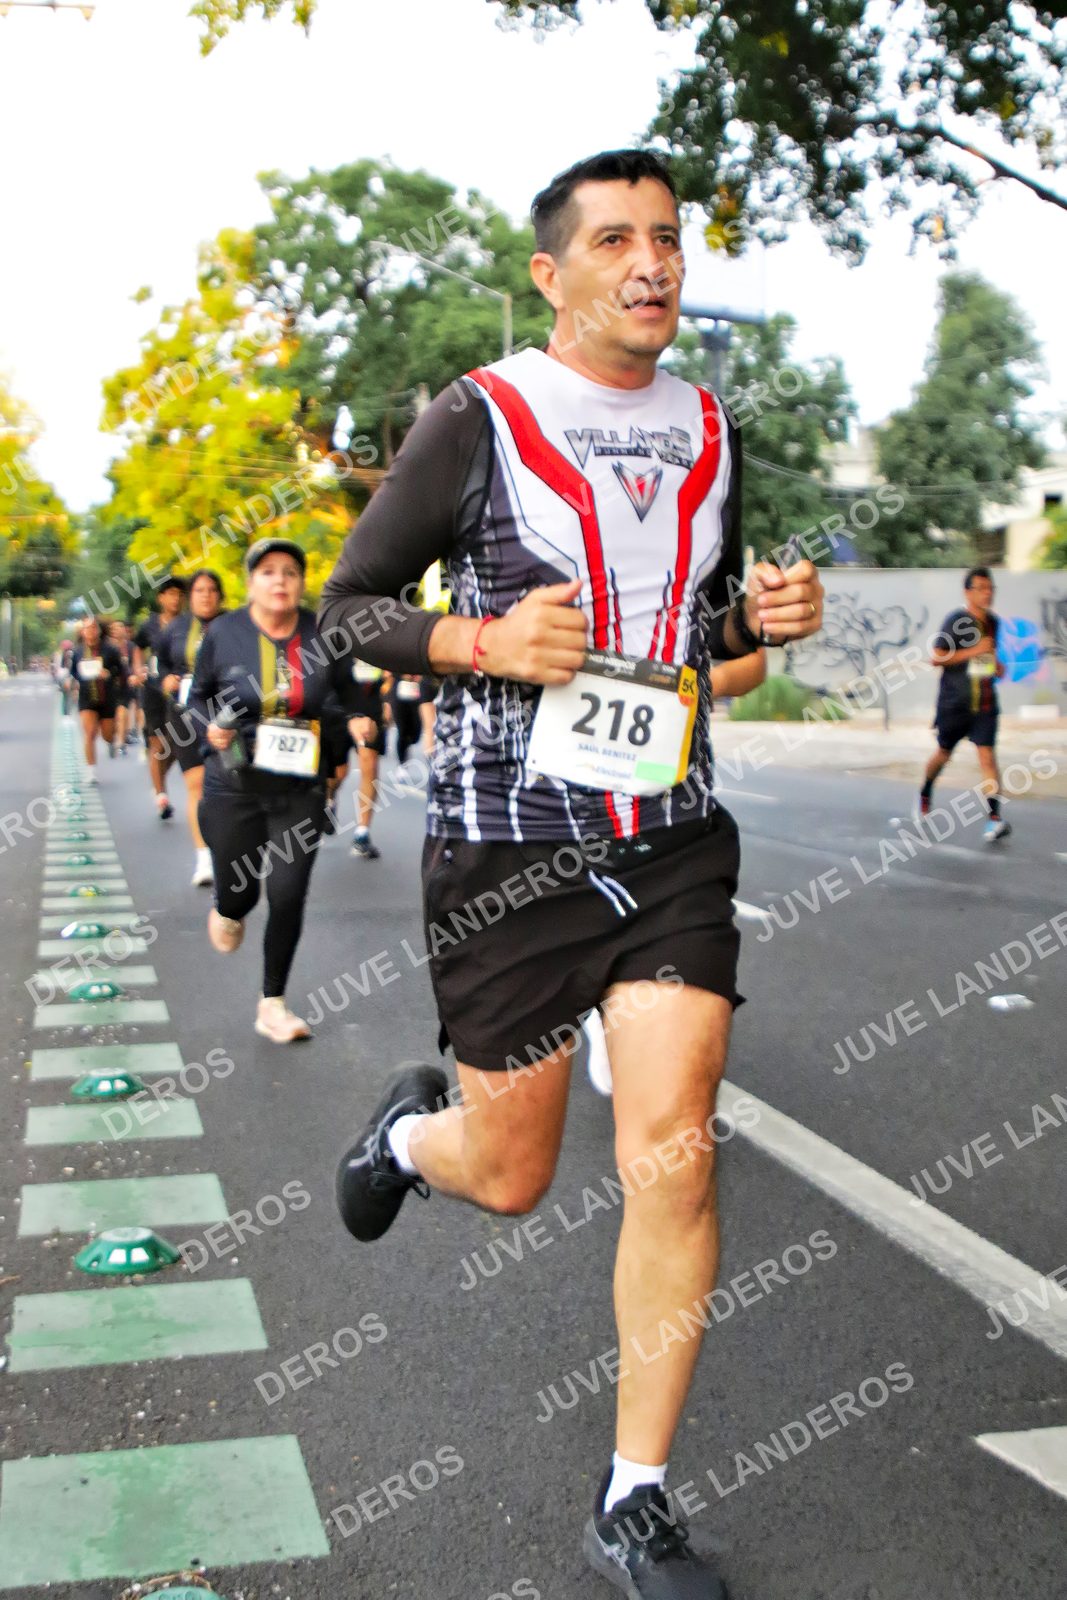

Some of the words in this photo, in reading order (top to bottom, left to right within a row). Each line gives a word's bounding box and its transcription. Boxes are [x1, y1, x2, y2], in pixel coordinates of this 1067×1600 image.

[563, 425, 694, 469] VILLANOS
[571, 692, 655, 747] 218
[267, 733, 309, 754] 7827
